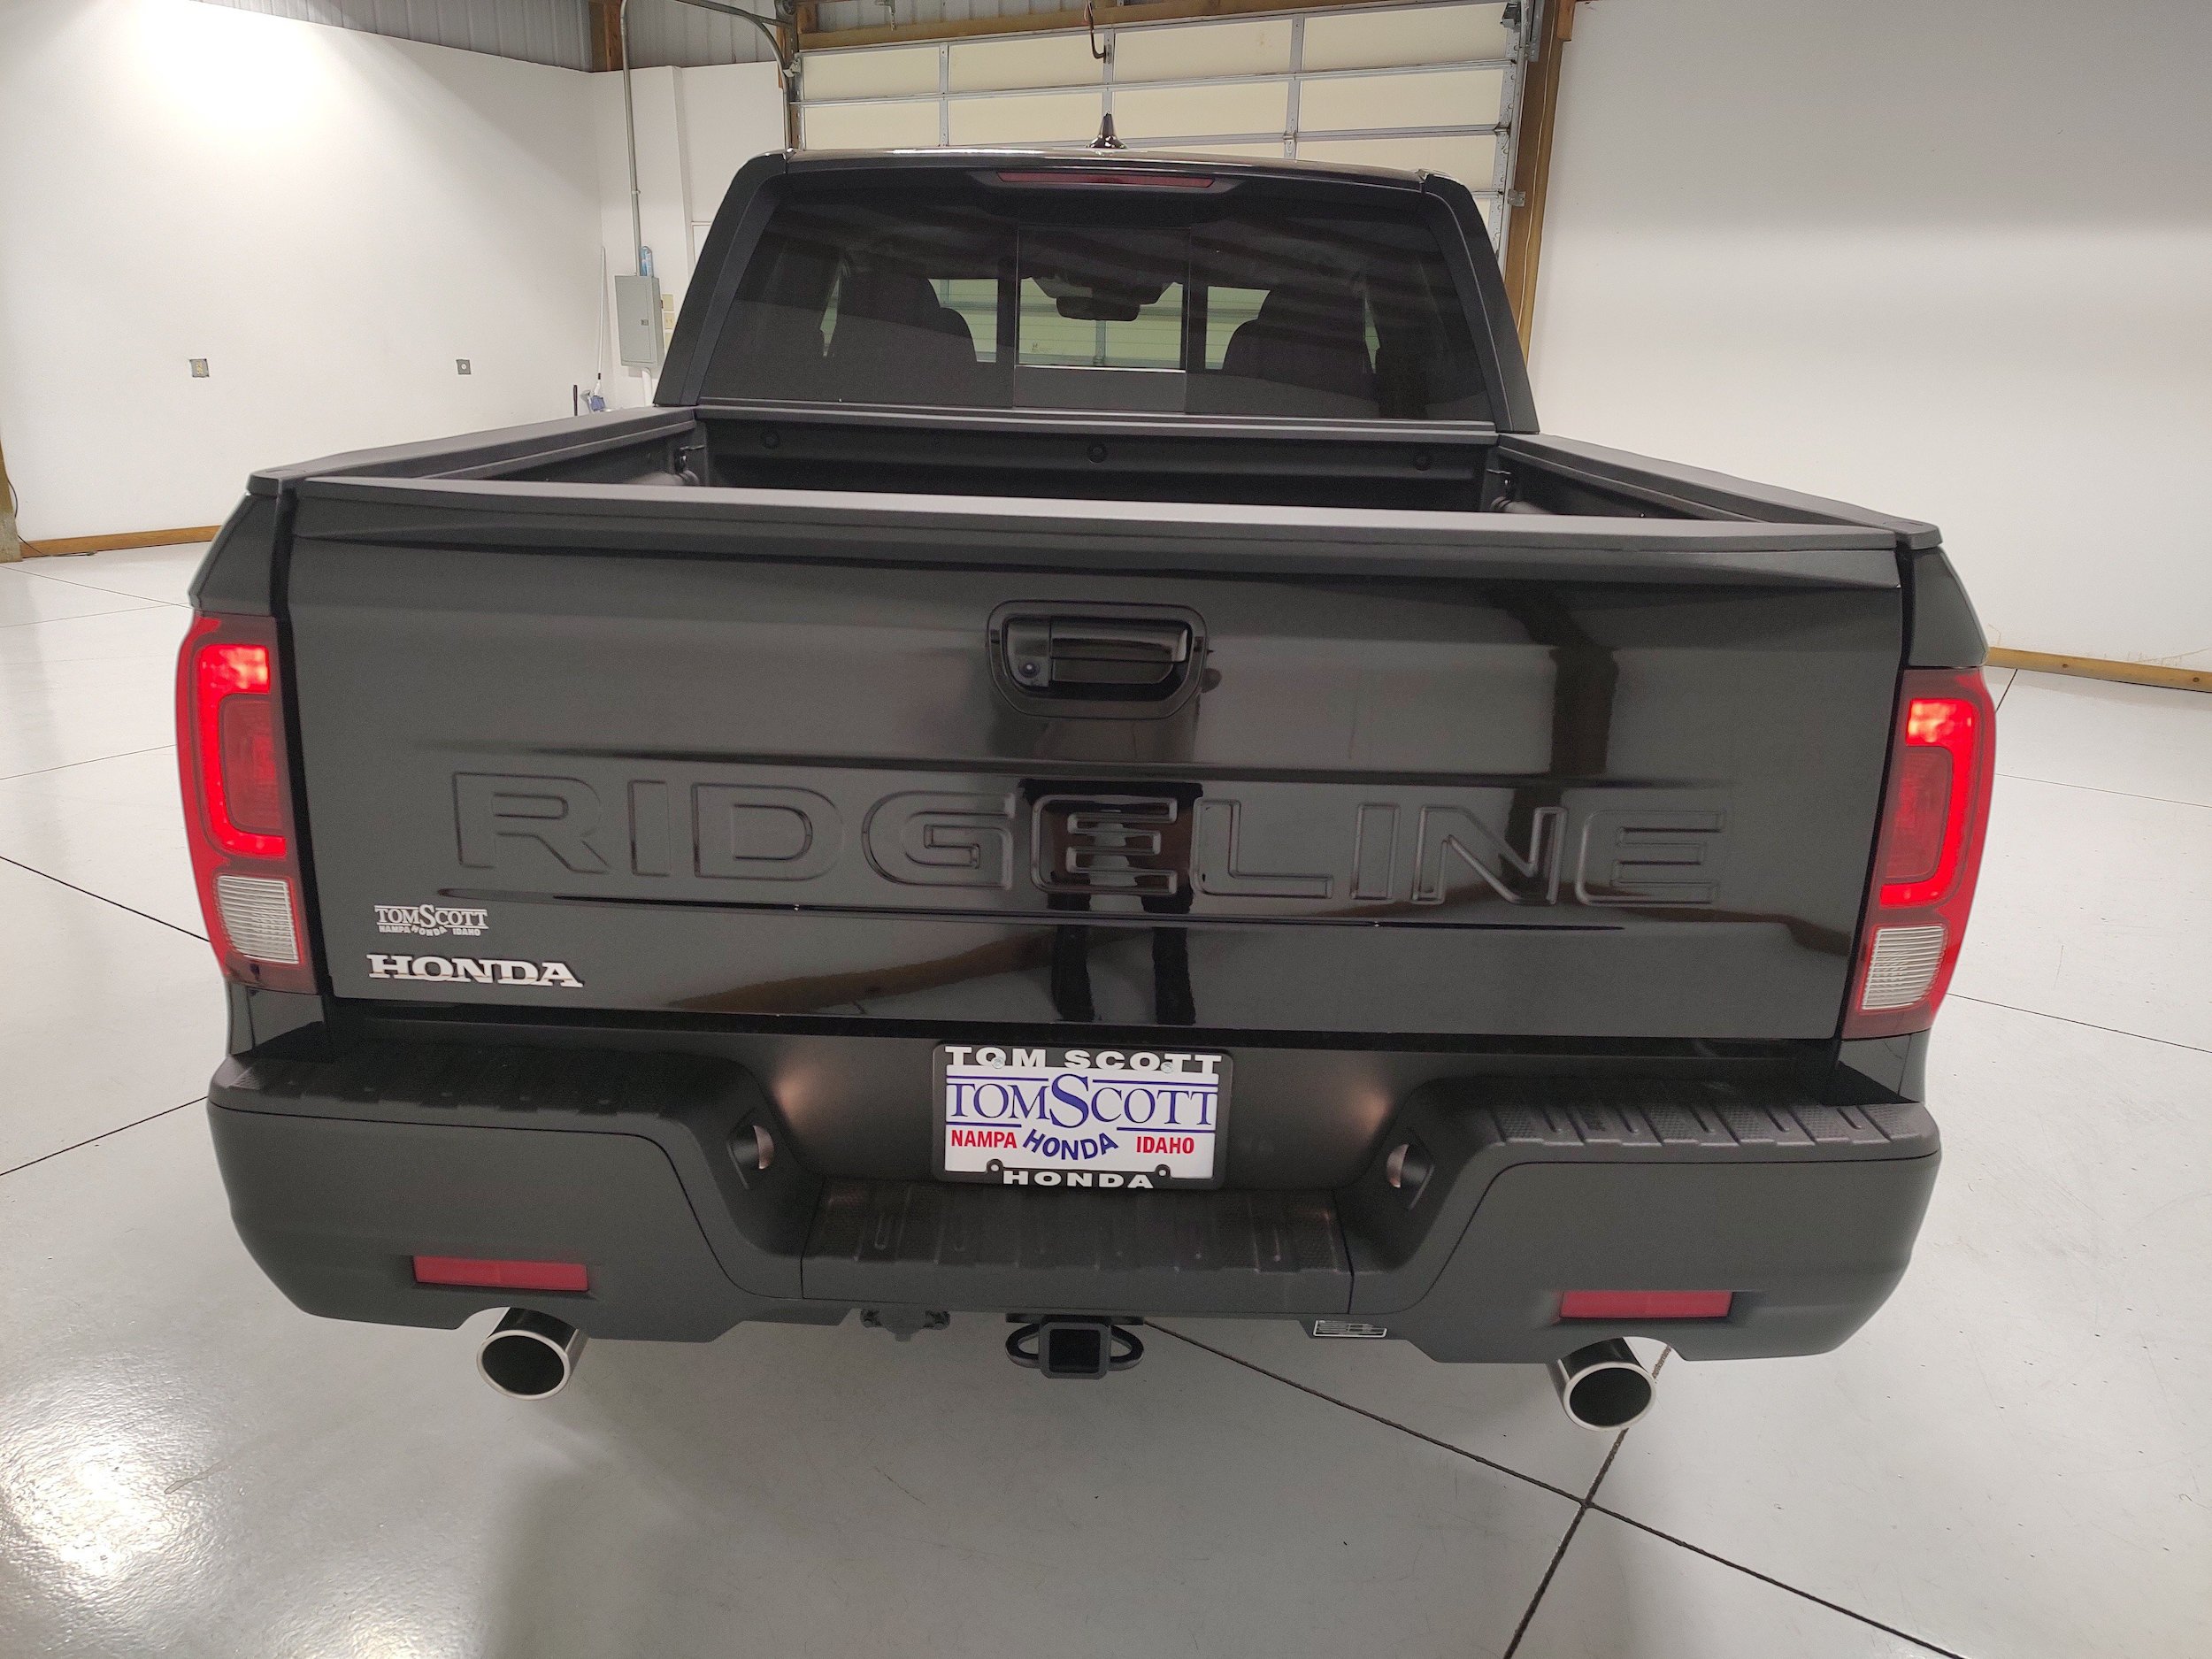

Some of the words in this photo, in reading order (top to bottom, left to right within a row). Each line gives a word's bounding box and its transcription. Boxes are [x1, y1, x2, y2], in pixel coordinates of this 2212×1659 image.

[452, 772, 1726, 907] RIDGELINE
[411, 925, 448, 936] HONDA
[452, 927, 481, 936] IDAHO
[366, 954, 584, 987] HONDA
[945, 1047, 1047, 1069] TOM
[1064, 1049, 1222, 1074] SCOTT
[951, 1130, 1017, 1148] NAMPA
[1023, 1129, 1118, 1160] HONDA
[1136, 1136, 1194, 1155] IDAHO
[1002, 1171, 1154, 1188] HONDA
